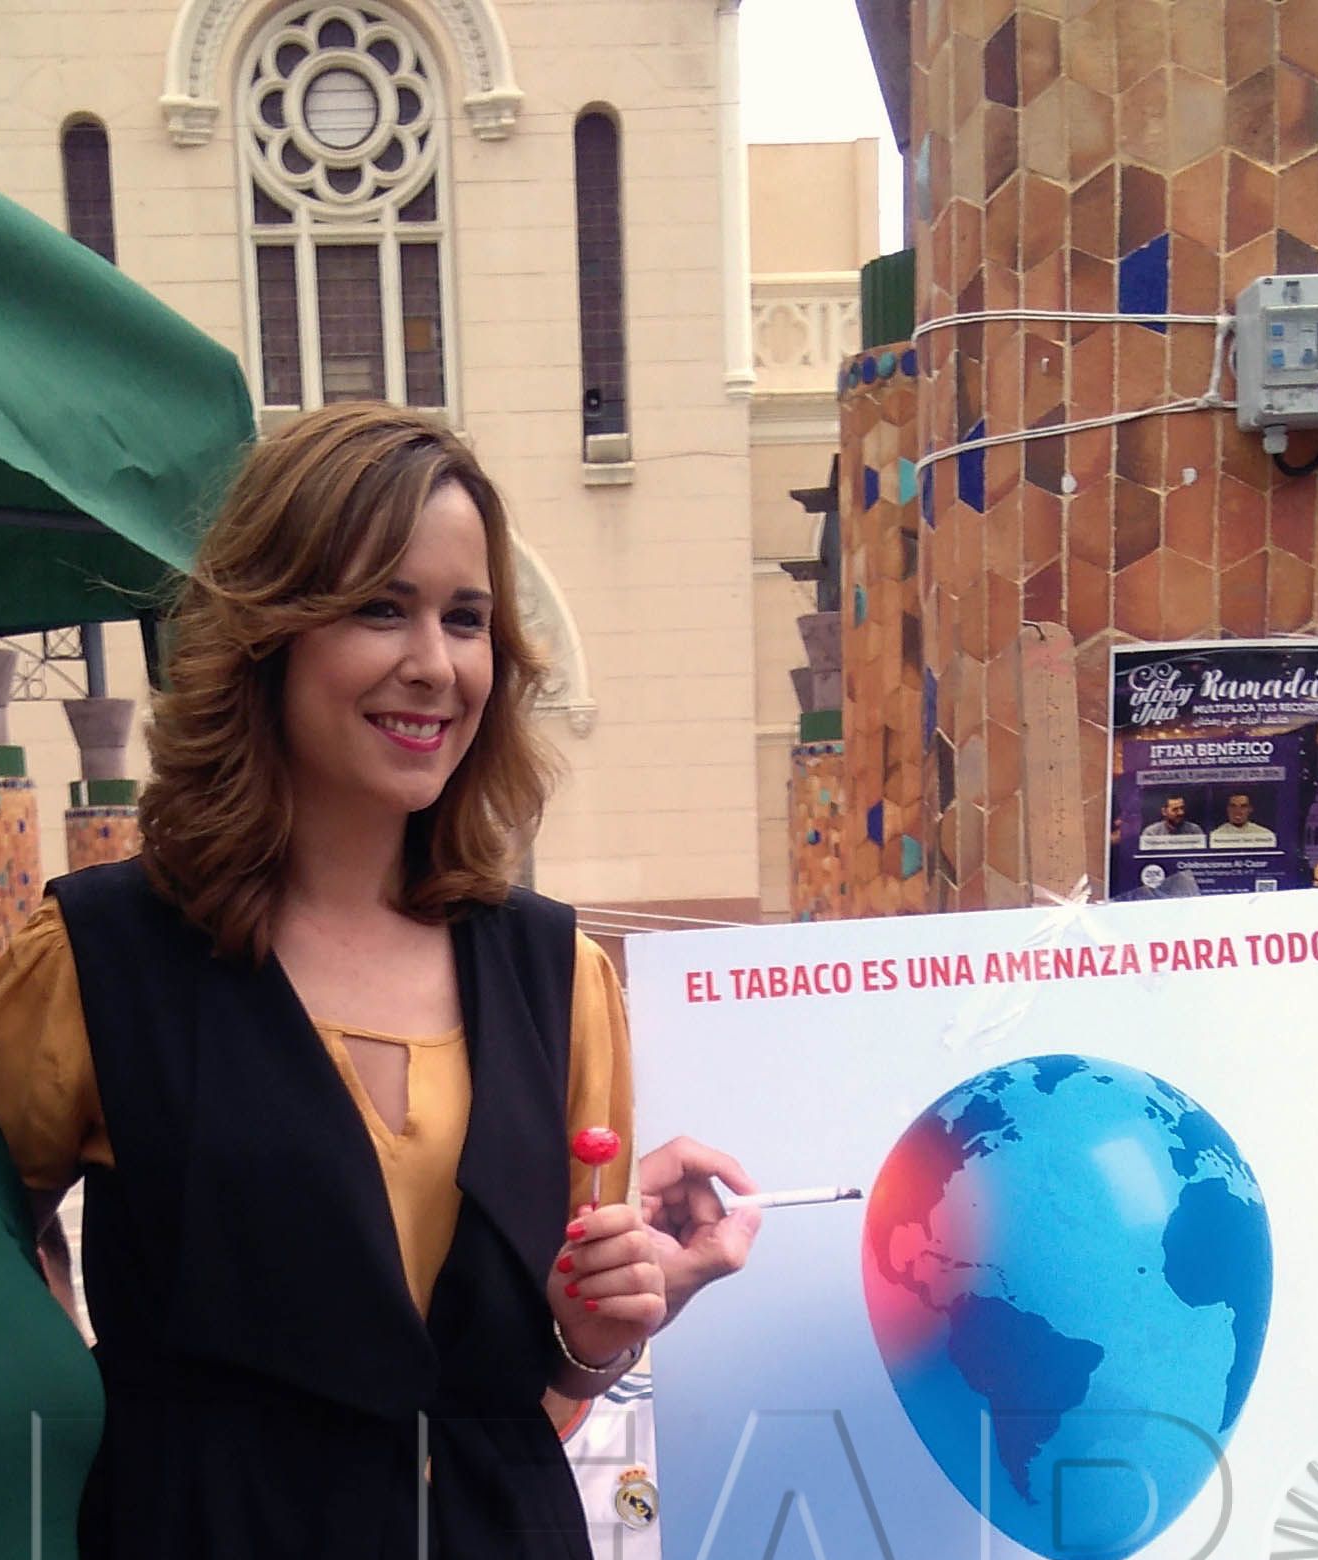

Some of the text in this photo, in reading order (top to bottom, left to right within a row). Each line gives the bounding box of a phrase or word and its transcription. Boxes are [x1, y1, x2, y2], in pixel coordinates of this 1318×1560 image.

[1150, 740, 1274, 759] IFTAR BENÉFICO
[686, 971, 722, 1004] EL
[729, 962, 853, 1000] TABACO
[861, 958, 899, 992] ES
[907, 954, 976, 989] UNA
[983, 943, 1142, 984] AMENAZA
[1148, 936, 1239, 974] PARA
